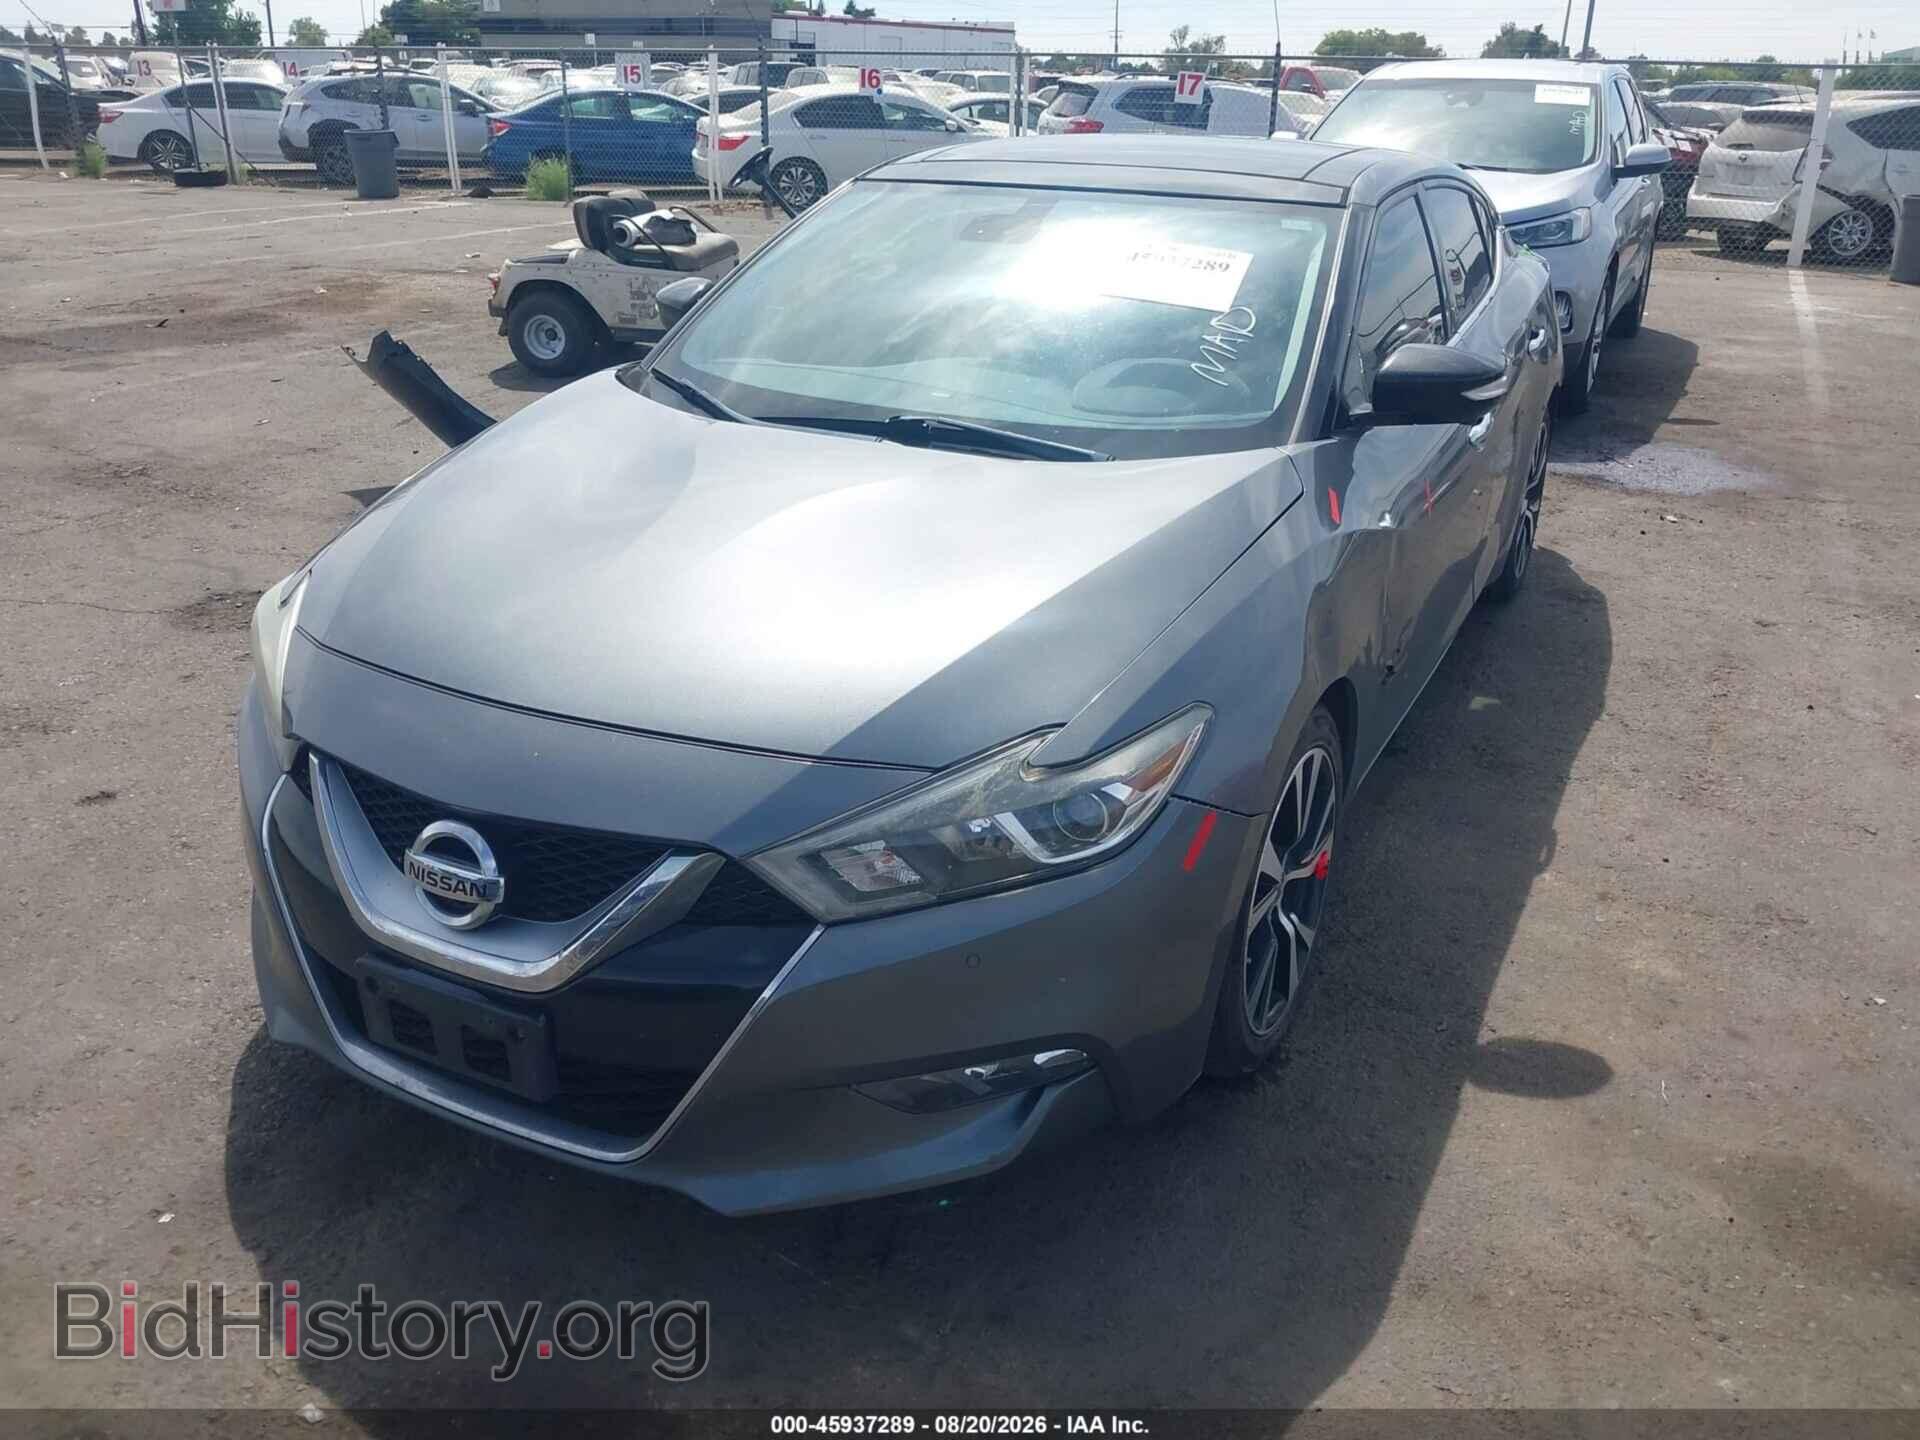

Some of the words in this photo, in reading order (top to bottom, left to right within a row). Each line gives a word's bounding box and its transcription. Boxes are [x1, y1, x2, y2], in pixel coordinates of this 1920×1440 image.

[137, 60, 152, 76] 13
[282, 61, 298, 77] 14
[623, 64, 642, 84] 15
[860, 68, 881, 88] 16
[1178, 73, 1204, 96] 17
[408, 860, 488, 898] NISSAN
